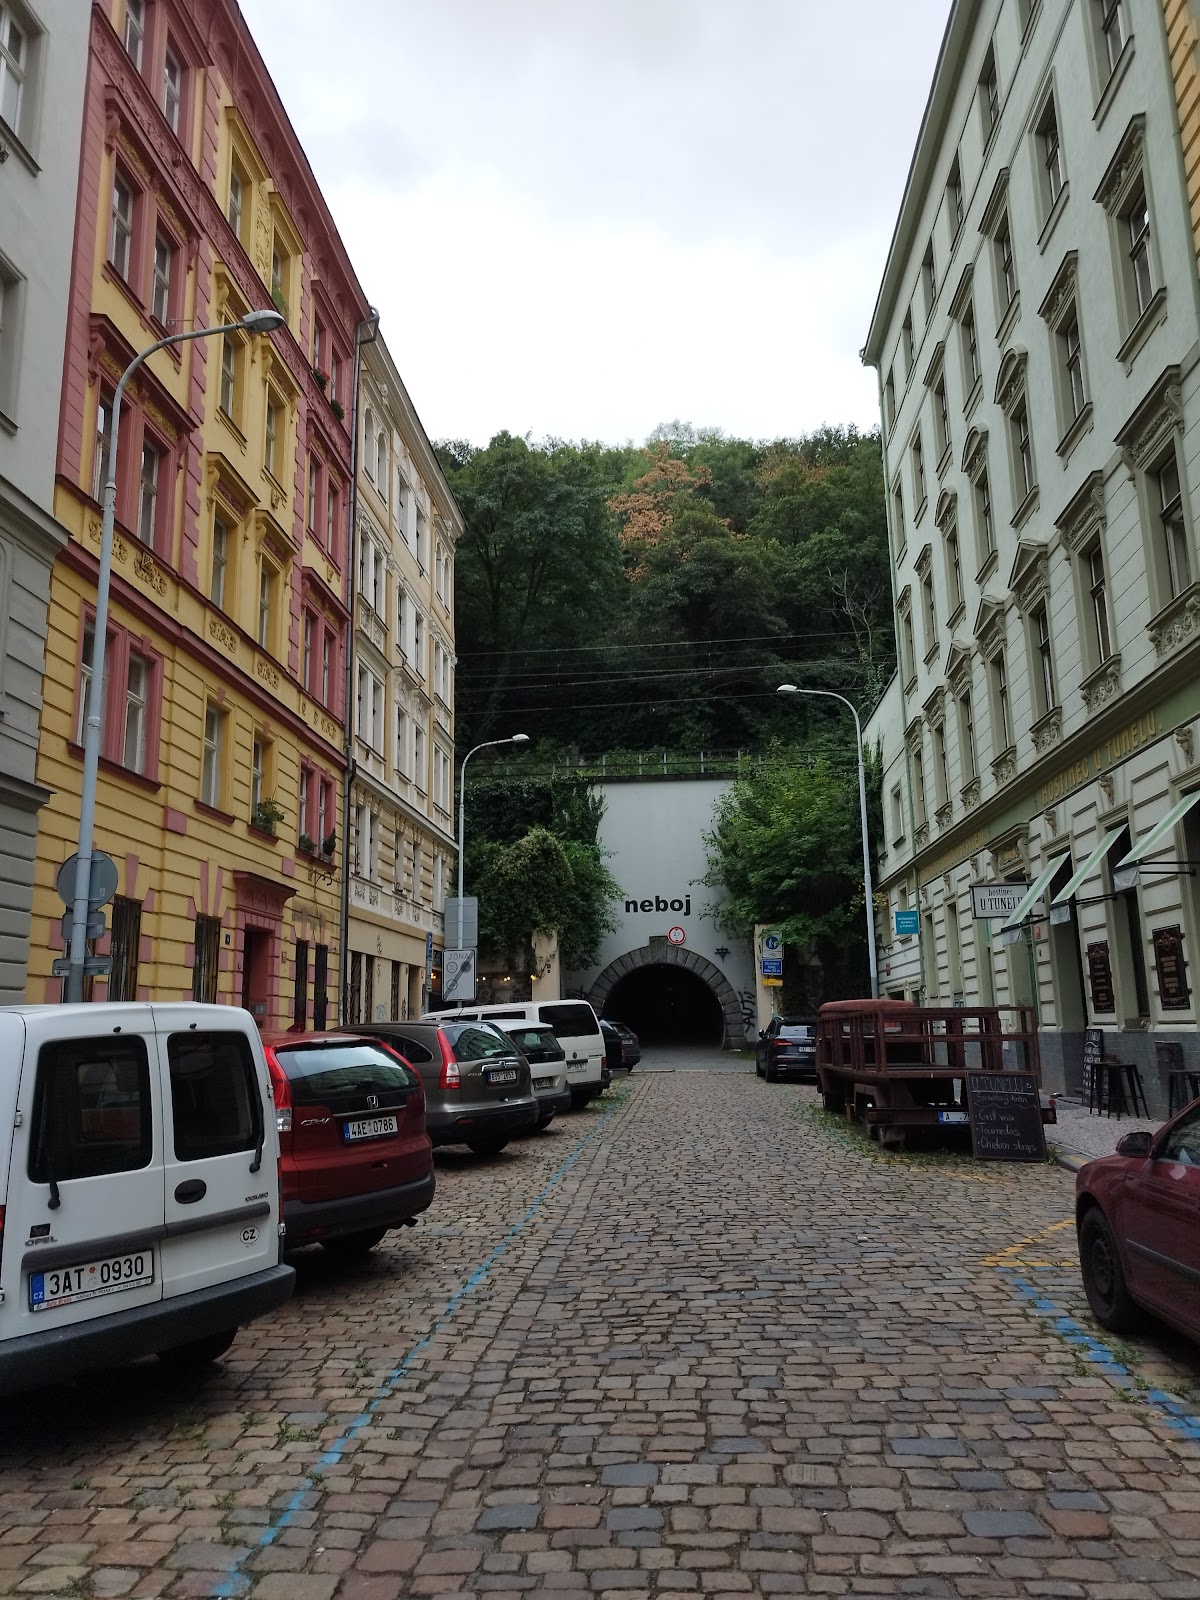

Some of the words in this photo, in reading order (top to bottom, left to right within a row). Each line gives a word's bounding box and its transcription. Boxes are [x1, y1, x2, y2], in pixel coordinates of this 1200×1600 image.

[1041, 758, 1089, 806] HOSTINEC
[1094, 746, 1102, 771] U
[988, 888, 1013, 897] hostinec
[625, 894, 691, 917] neboj
[980, 898, 986, 911] U
[971, 1077, 979, 1090] U
[980, 1137, 1009, 1150] Chicken
[1014, 1140, 1037, 1154] strips
[243, 1229, 256, 1241] CZ
[25, 1237, 57, 1247] OPEL
[50, 1266, 84, 1296] 3AT
[100, 1255, 144, 1284] 0930
[33, 1291, 44, 1300] CZ
